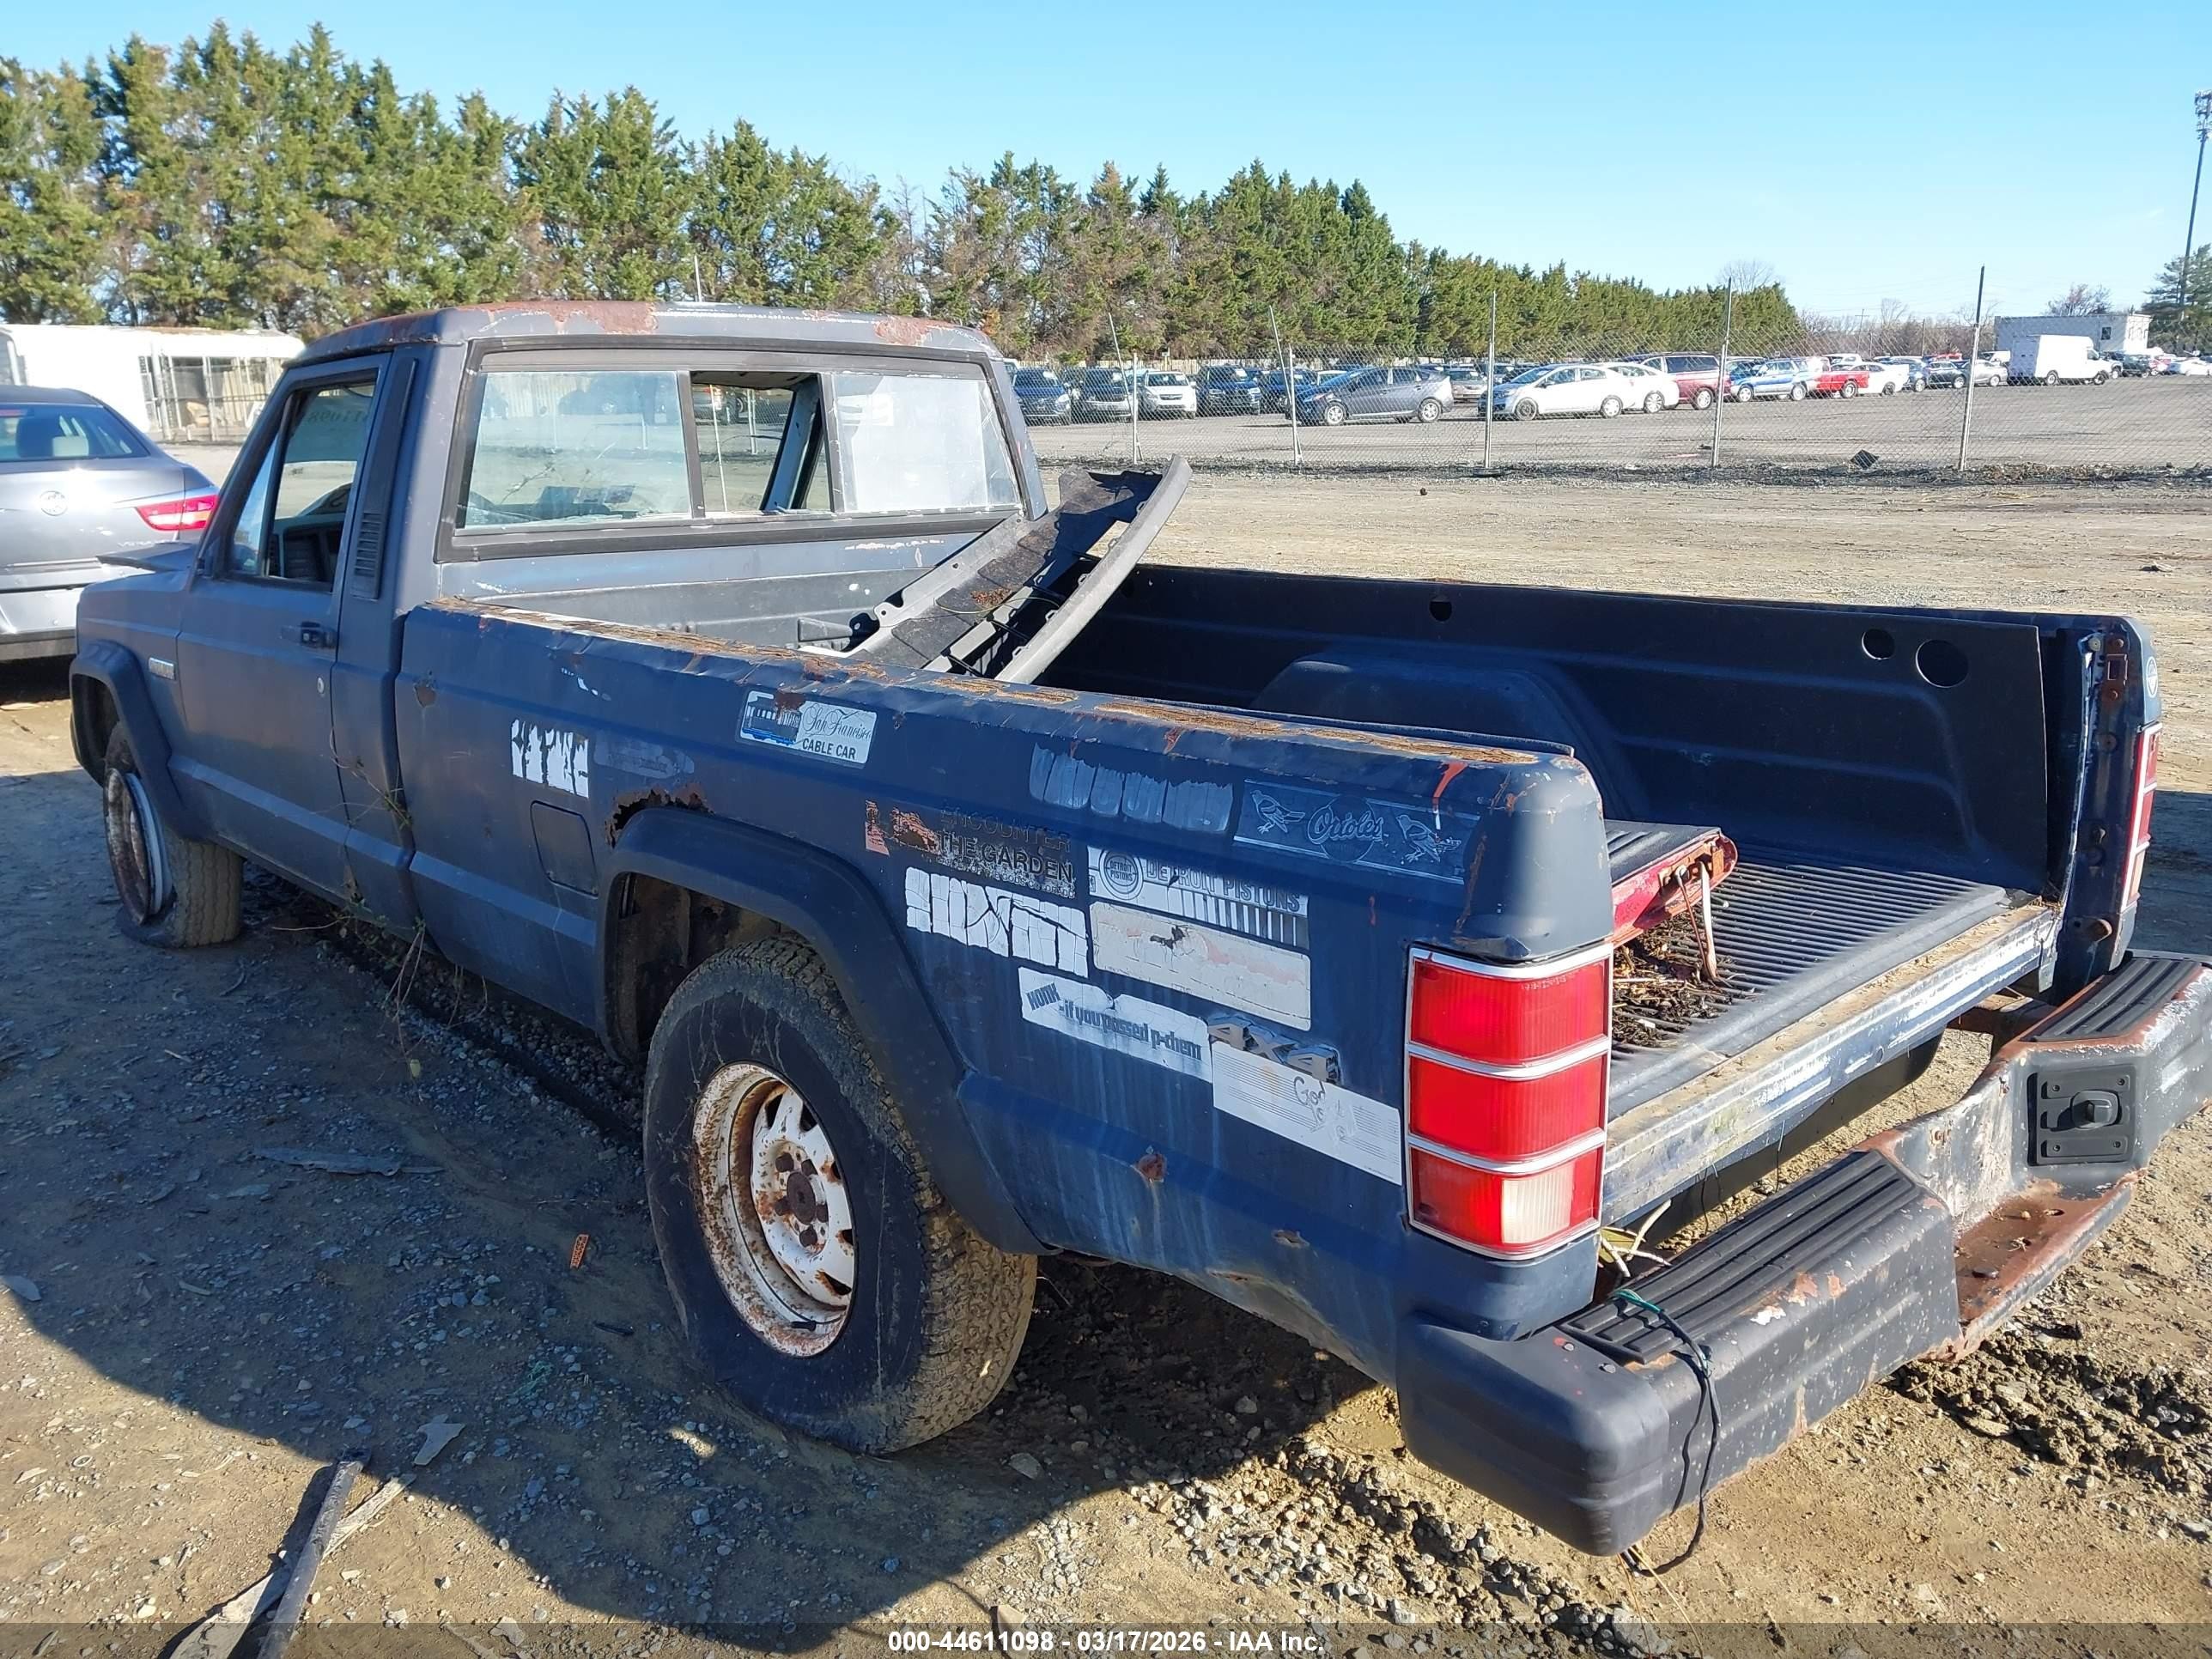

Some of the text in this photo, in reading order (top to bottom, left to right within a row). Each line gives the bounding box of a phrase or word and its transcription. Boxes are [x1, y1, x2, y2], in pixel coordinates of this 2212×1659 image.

[802, 703, 871, 739] San Francisco
[802, 738, 856, 760] CABLE CAR
[1308, 805, 1384, 844] Orioles
[938, 830, 1073, 883] THE GARDEN
[1109, 860, 1133, 882] DETROIT PISTONS
[1146, 859, 1300, 913] DETROIT PISTONS
[1075, 1006, 1102, 1026] you
[1102, 1012, 1149, 1042] passed
[1150, 1029, 1202, 1060] p-chem
